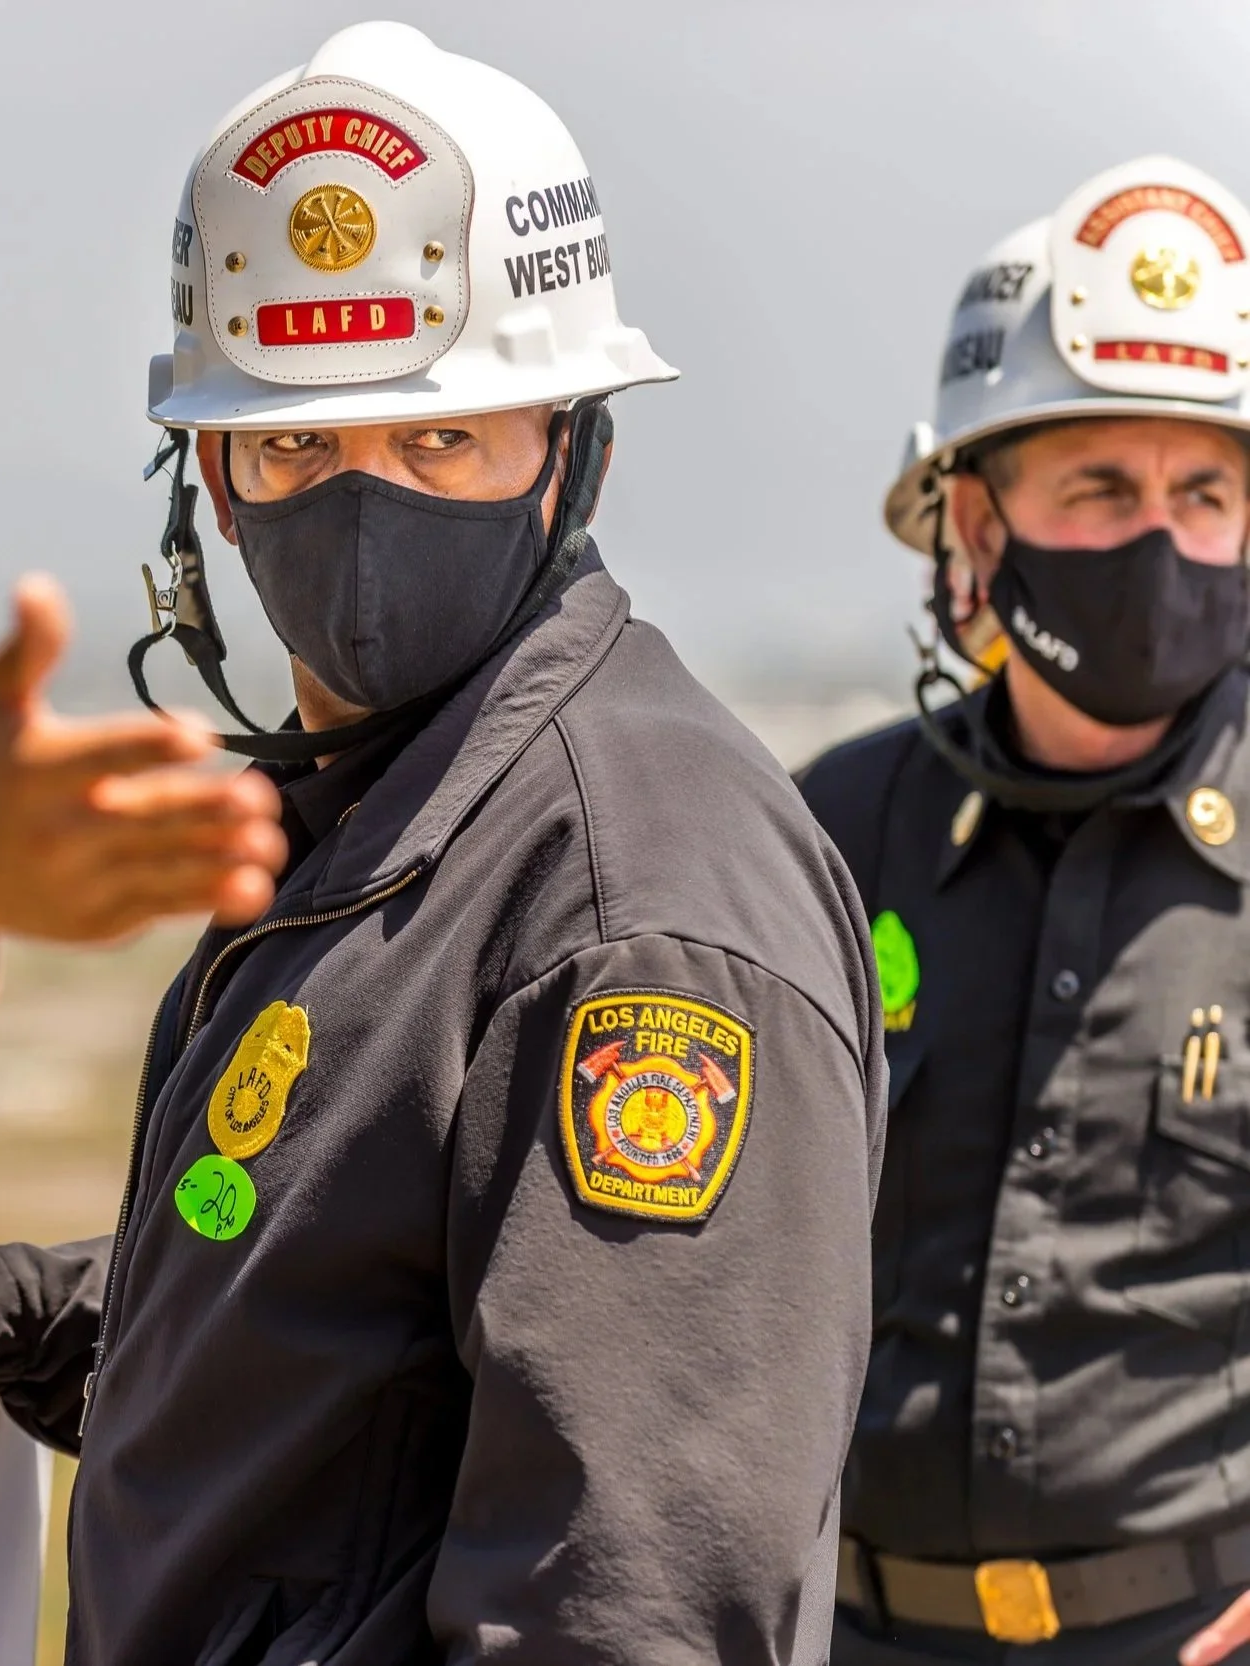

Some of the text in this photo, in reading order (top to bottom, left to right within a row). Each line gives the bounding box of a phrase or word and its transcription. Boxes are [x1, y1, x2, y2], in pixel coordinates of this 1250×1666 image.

[243, 115, 415, 180] DEPUTY CHIEF
[503, 242, 581, 299] WEST
[285, 303, 386, 336] LAFD
[587, 1007, 739, 1058] LOS ANGELES
[634, 1031, 691, 1059] FIRE
[238, 1067, 272, 1100] LAFD
[225, 1086, 269, 1133] CITY OF LOS ANGELES
[589, 1170, 701, 1206] DEPARTMENT
